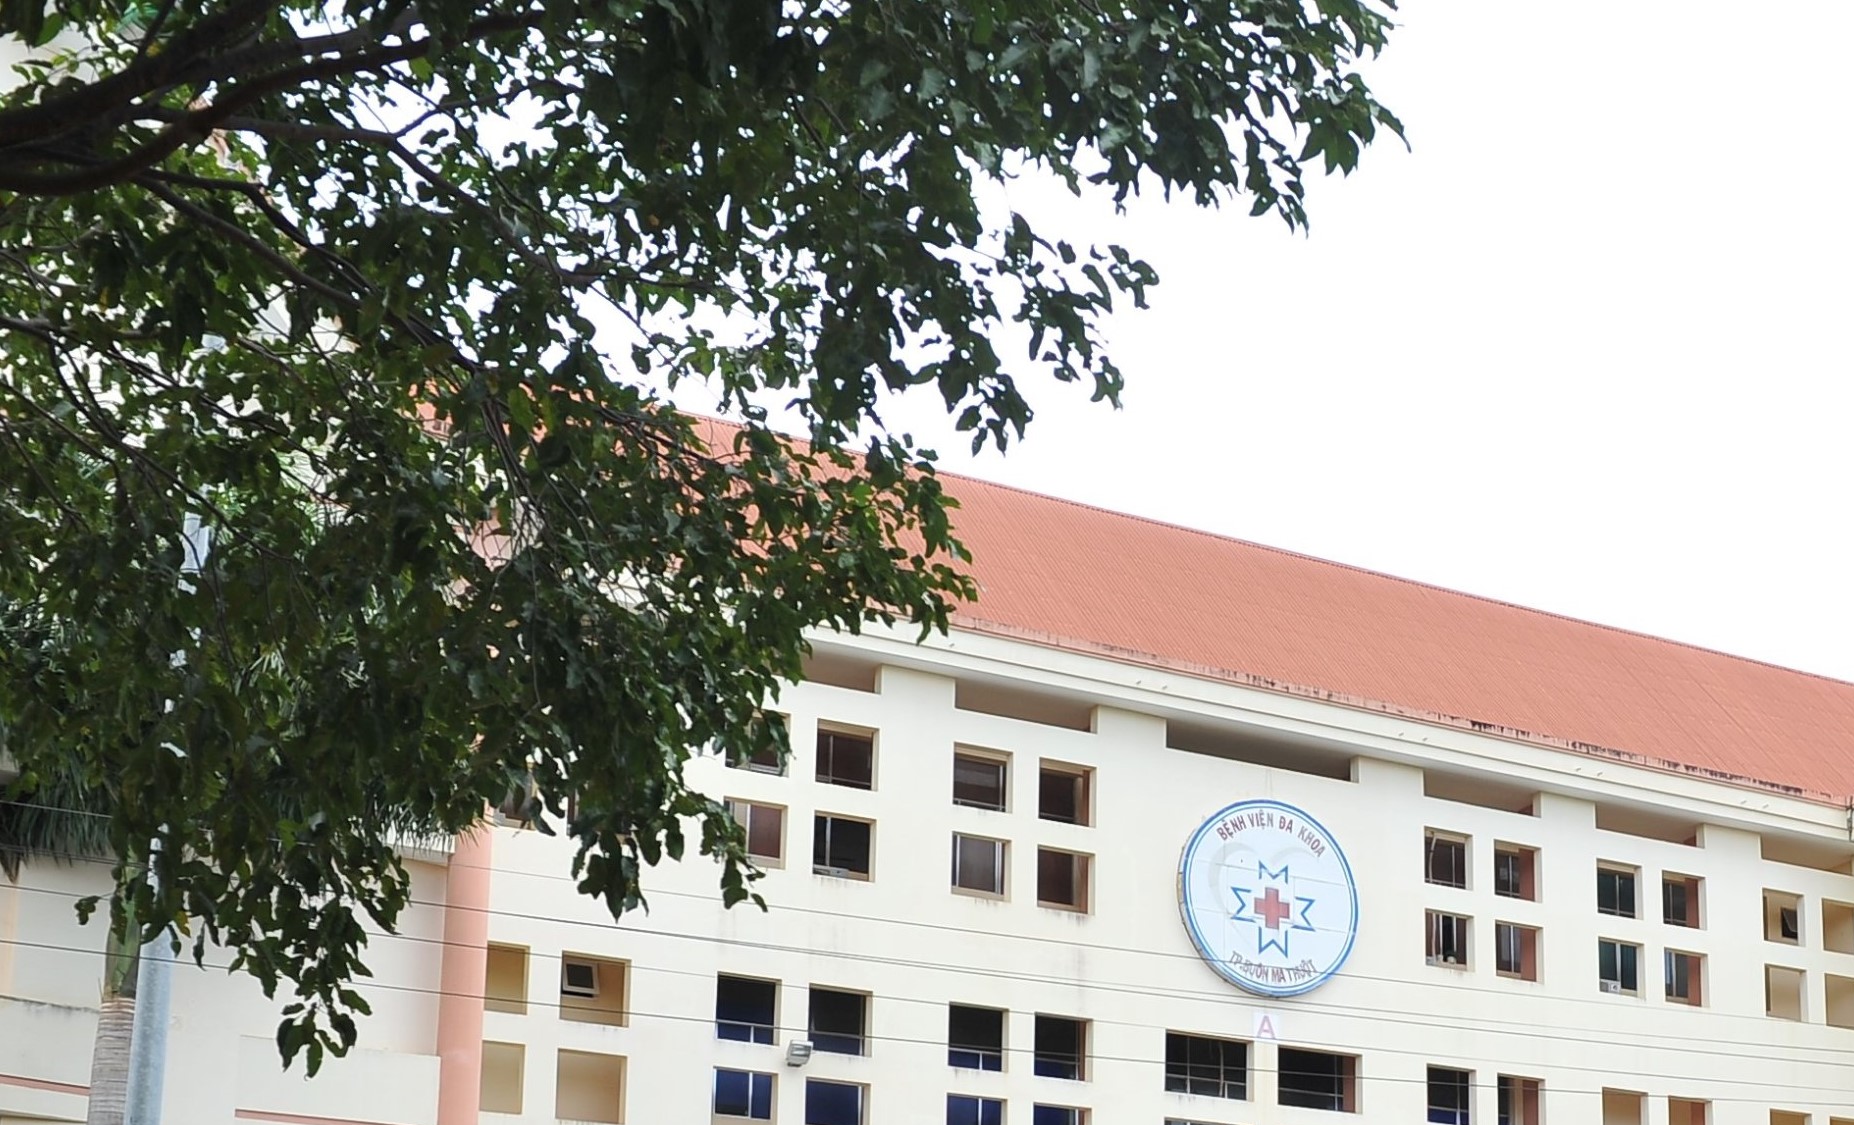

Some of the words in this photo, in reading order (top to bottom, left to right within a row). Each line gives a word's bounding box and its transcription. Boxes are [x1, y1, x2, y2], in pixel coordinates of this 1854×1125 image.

[1216, 814, 1247, 841] BỆNH
[1247, 809, 1274, 830] VIỆN
[1279, 815, 1294, 834] ĐA
[1297, 825, 1326, 858] KHOA
[1271, 968, 1287, 983] MA
[1257, 1015, 1276, 1039] A
